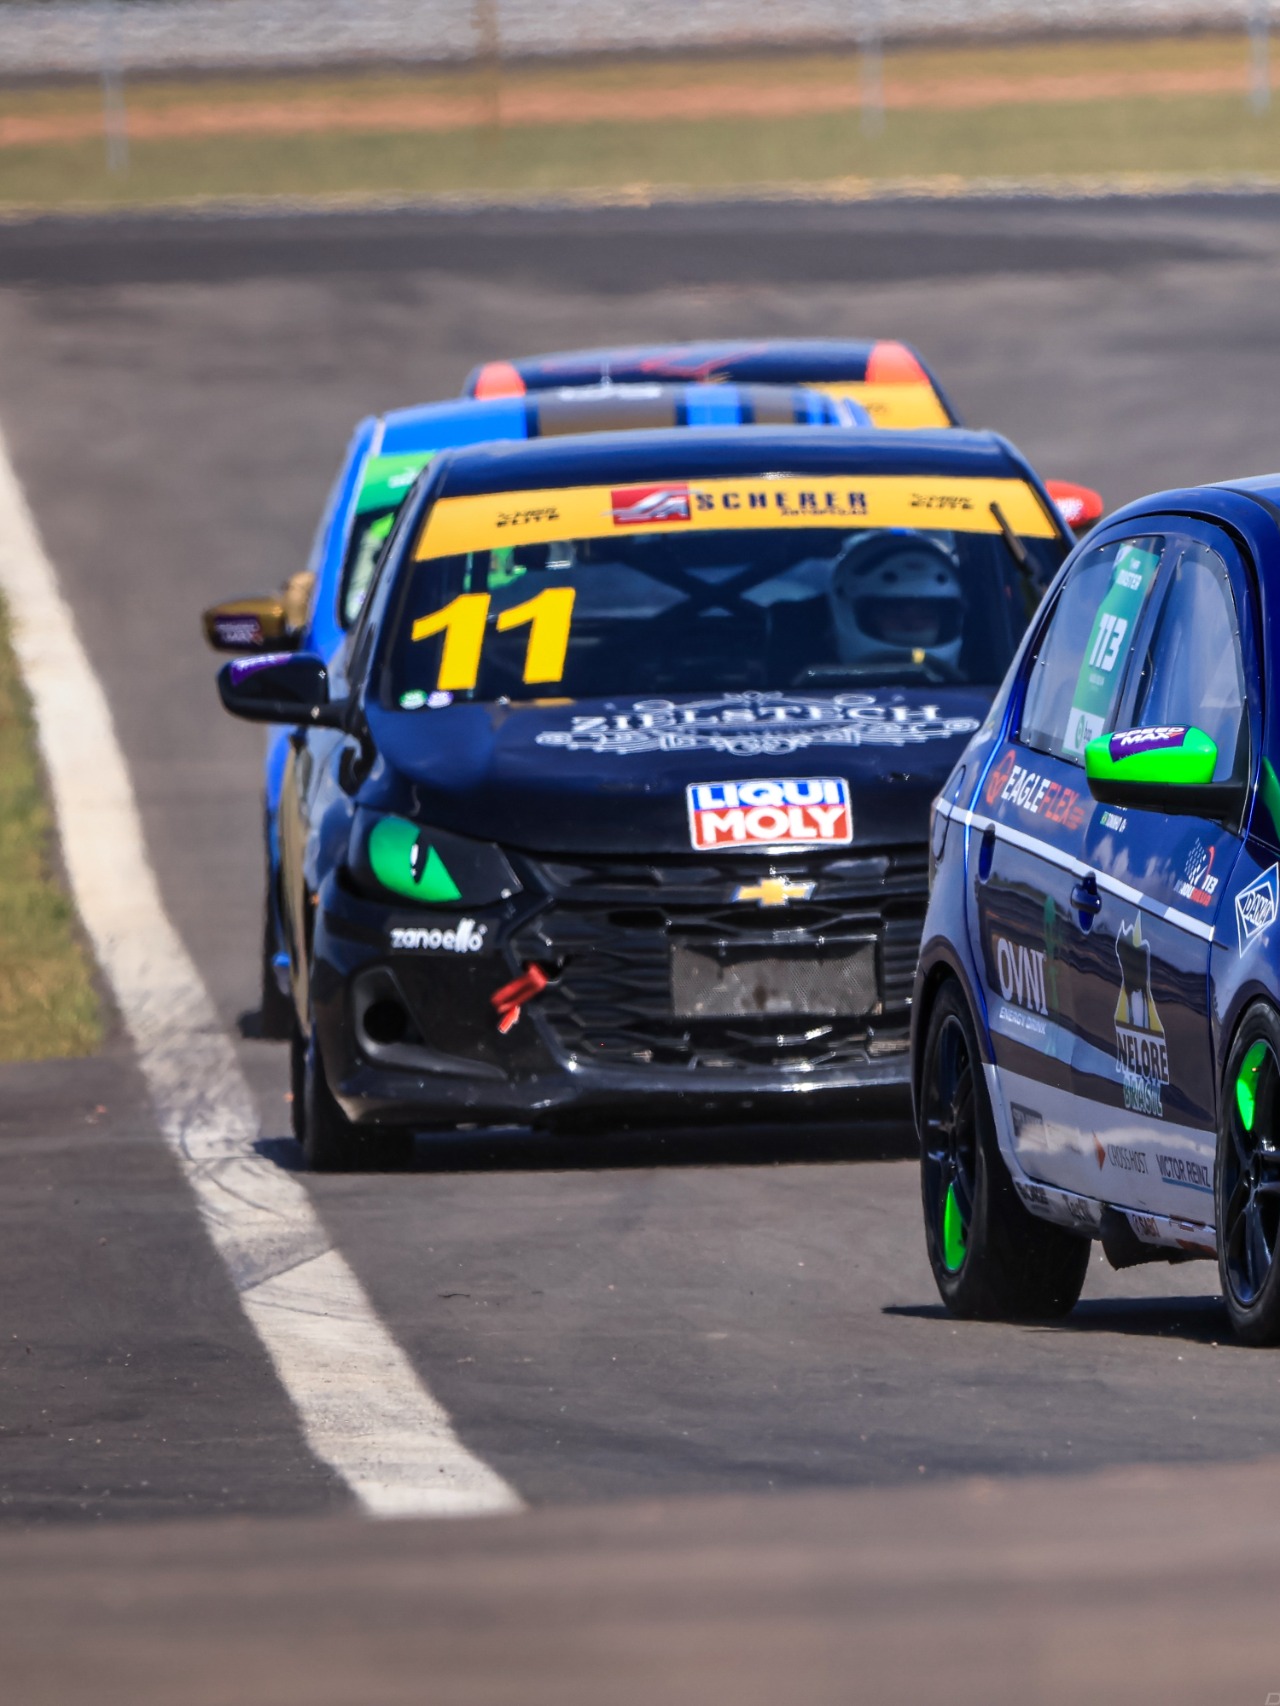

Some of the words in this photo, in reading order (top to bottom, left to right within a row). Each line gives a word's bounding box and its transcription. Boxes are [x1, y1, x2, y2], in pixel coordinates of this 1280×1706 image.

[410, 586, 576, 690] 11
[1088, 612, 1129, 673] 113
[1120, 731, 1171, 747] MAX
[697, 779, 843, 809] LIQUI
[701, 805, 846, 842] MOLY
[389, 917, 484, 954] zanoello
[997, 937, 1049, 1016] OVNI
[1116, 1032, 1168, 1082] NELORE
[1155, 1154, 1186, 1182] VICTOR
[1186, 1160, 1211, 1188] REINZ
